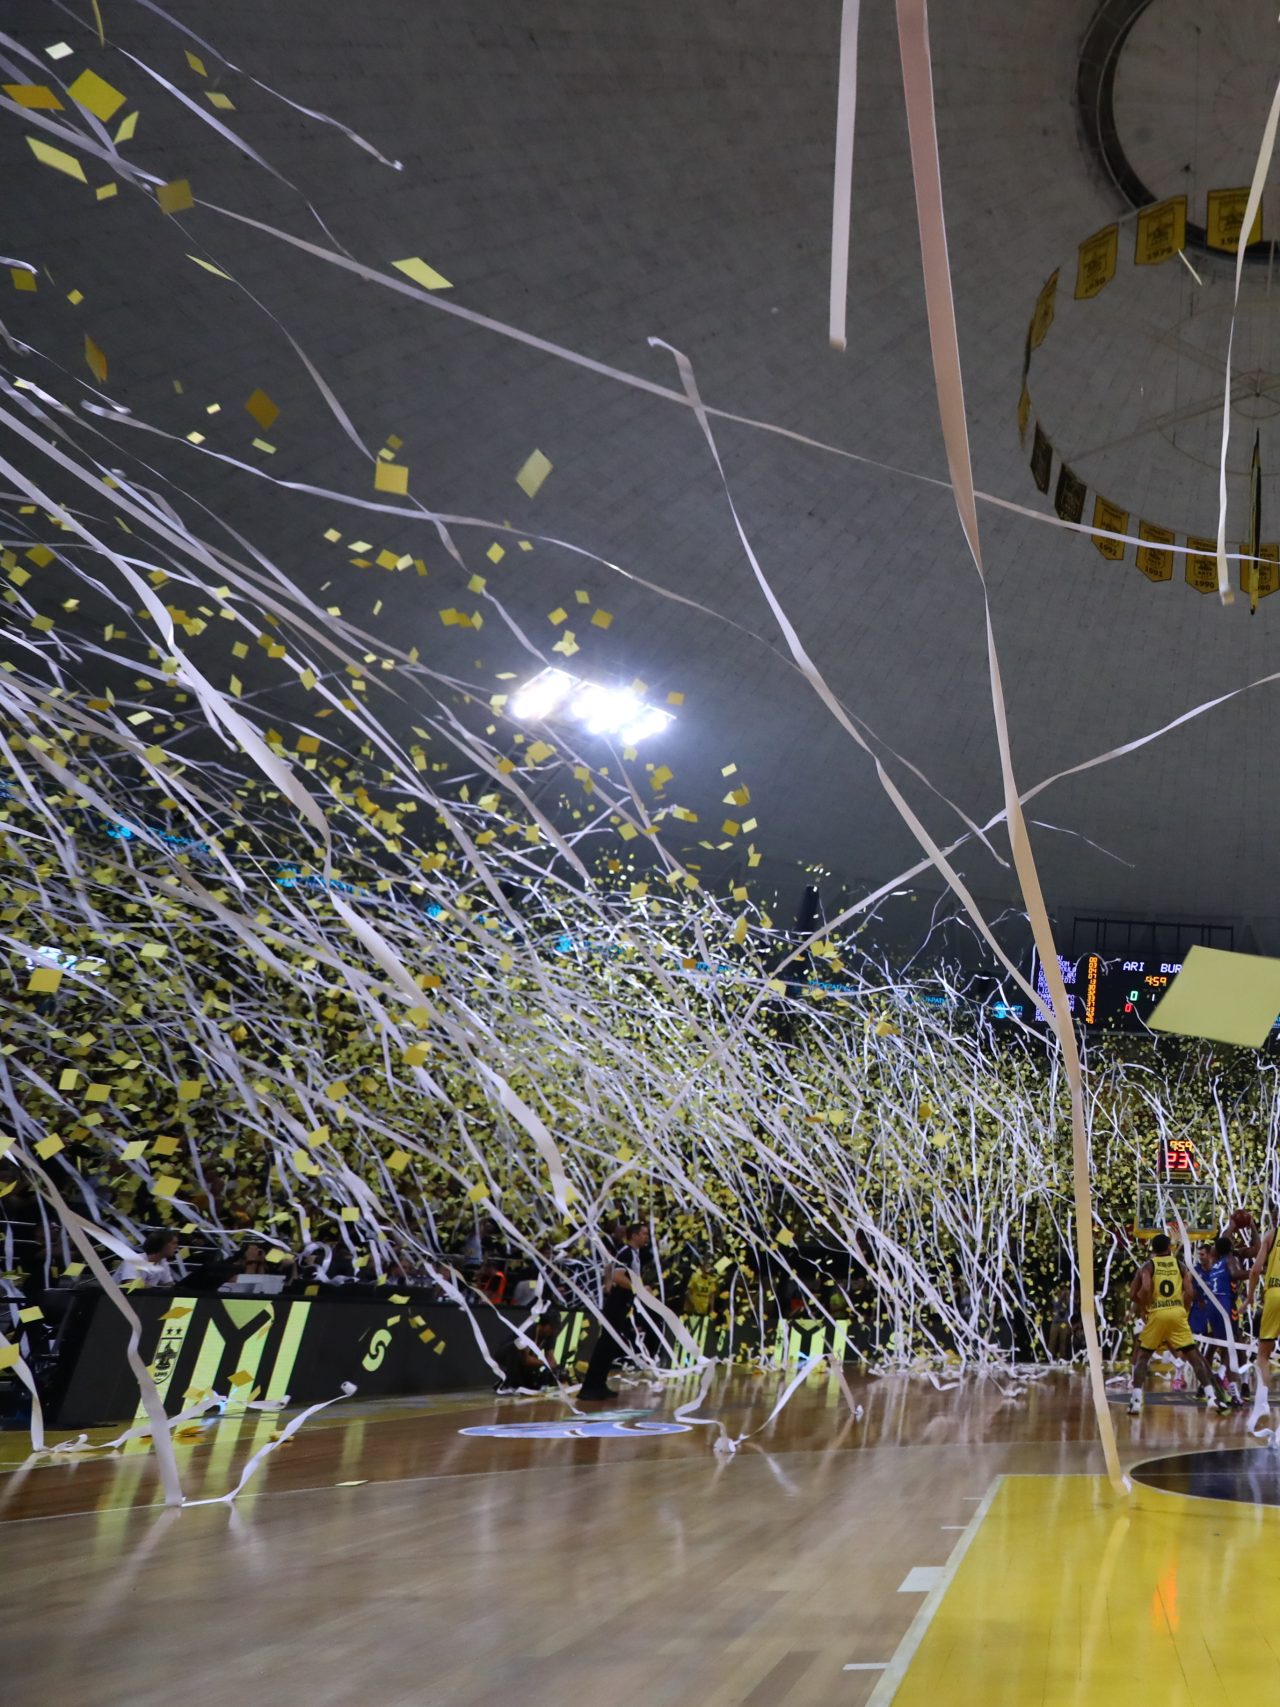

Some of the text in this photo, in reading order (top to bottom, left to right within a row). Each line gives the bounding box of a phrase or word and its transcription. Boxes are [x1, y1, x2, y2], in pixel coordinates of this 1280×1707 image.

[1194, 580, 1215, 588] 1990
[1122, 961, 1183, 974] ARI BUR
[1129, 990, 1139, 1001] 0
[1166, 1151, 1189, 1169] 23
[1160, 1279, 1175, 1298] 0
